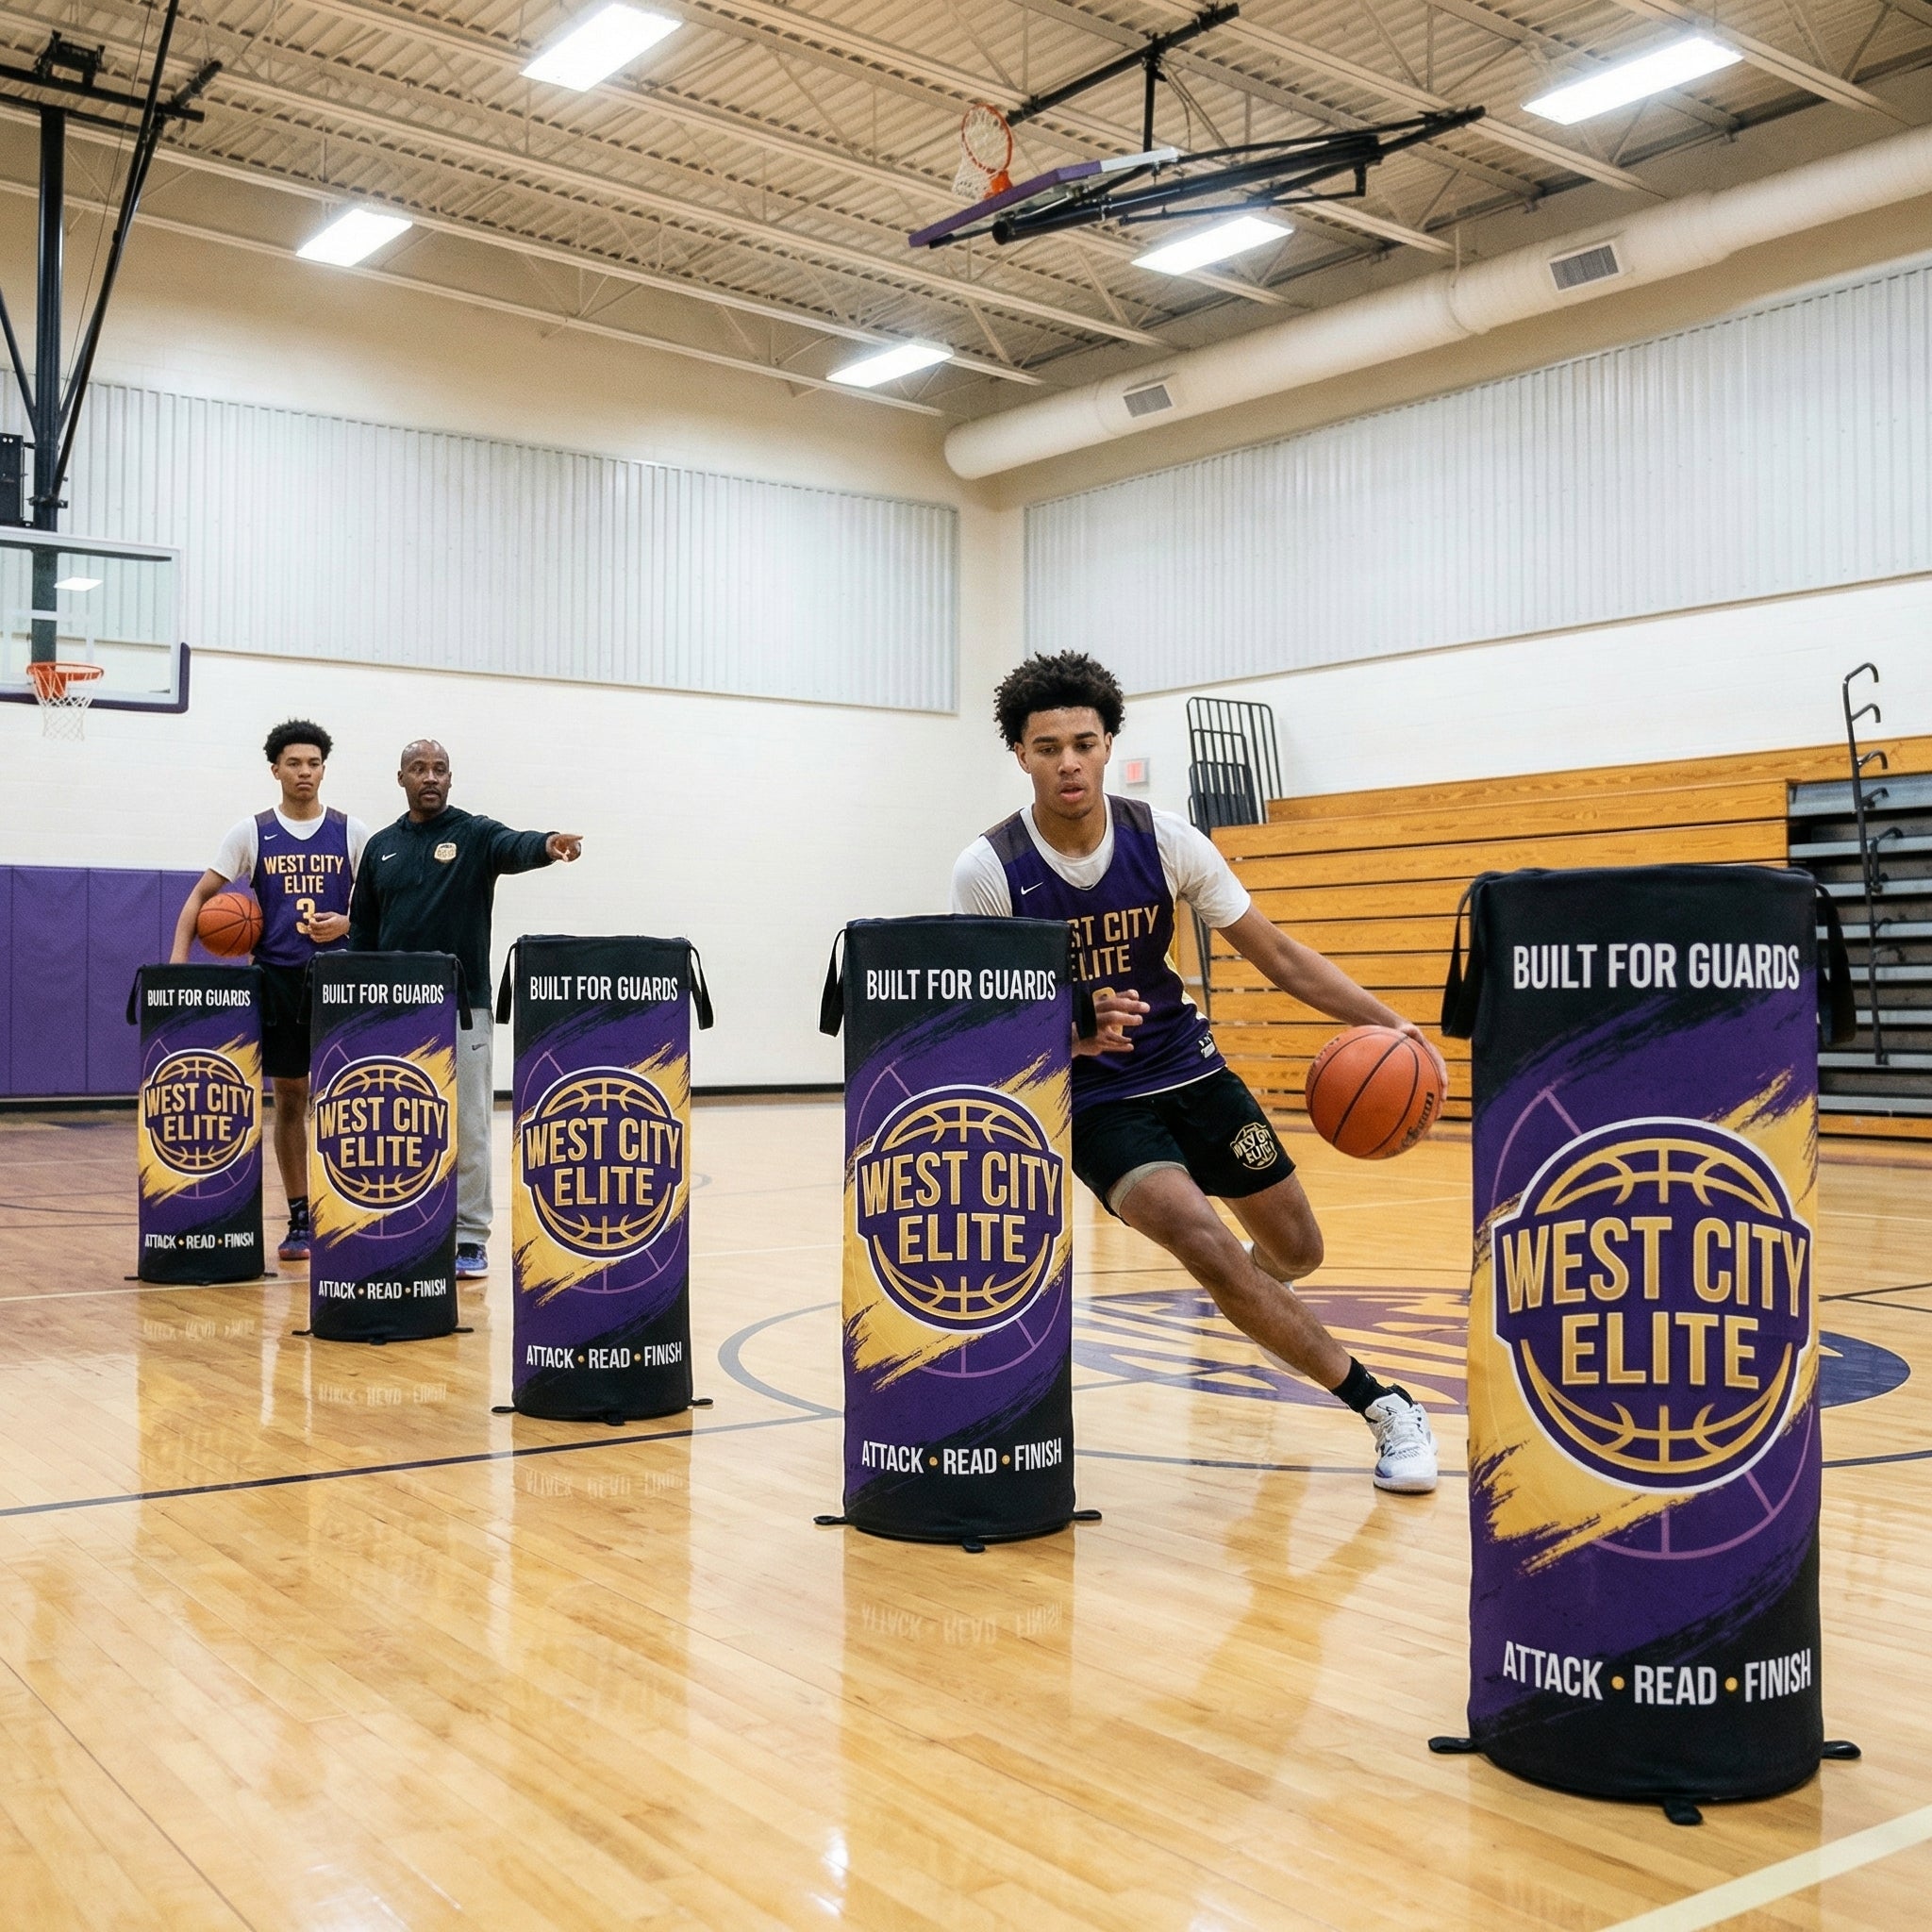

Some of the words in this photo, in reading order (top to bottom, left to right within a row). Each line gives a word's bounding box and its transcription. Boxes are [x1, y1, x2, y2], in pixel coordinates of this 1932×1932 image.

[263, 854, 306, 874] WEST
[309, 854, 344, 874] CITY
[284, 874, 325, 894] ELITE
[295, 897, 316, 934] 3
[1103, 905, 1159, 942] CITY
[1513, 944, 1598, 989] BUILT
[1608, 942, 1677, 988] FOR
[1689, 942, 1800, 990] GUARDS
[147, 990, 175, 1007] BUILT
[177, 989, 202, 1006] FOR
[206, 990, 251, 1007] GUARDS
[322, 984, 356, 1004] BUILT
[359, 984, 389, 1004] FOR
[392, 984, 444, 1004] GUARDS
[530, 975, 572, 1001] BUILT
[576, 975, 612, 1000] FOR
[617, 975, 678, 1002] GUARDS
[866, 969, 921, 1001] BUILT
[927, 969, 973, 1000] FOR
[979, 969, 1056, 1001] GUARDS
[146, 1082, 200, 1118] WEST
[207, 1083, 252, 1117] CITY
[319, 1096, 385, 1140] WEST
[393, 1096, 446, 1140] CITY
[163, 1114, 233, 1142] ELITE
[525, 1117, 608, 1170] WEST
[619, 1117, 679, 1169] CITY
[340, 1136, 423, 1169] ELITE
[554, 1166, 654, 1207] ELITE
[861, 1151, 969, 1218] WEST
[982, 1151, 1059, 1216] CITY
[144, 1233, 177, 1249] ATTACK
[186, 1234, 216, 1250] READ
[225, 1231, 254, 1248] FINISH
[898, 1212, 1026, 1264] ELITE
[1502, 1216, 1673, 1314] WEST
[1692, 1217, 1807, 1318] CITY
[318, 1280, 356, 1299] ATTACK
[367, 1282, 402, 1300] READ
[413, 1278, 446, 1298] FINISH
[526, 1344, 575, 1369] ATTACK
[588, 1348, 631, 1369] READ
[643, 1341, 682, 1367] FINISH
[1562, 1311, 1759, 1391] ELITE
[861, 1441, 924, 1474] ATTACK
[943, 1448, 997, 1474] READ
[1014, 1437, 1062, 1472] FINISH
[1503, 1640, 1603, 1701] ATTACK
[1634, 1664, 1717, 1706] READ
[1745, 1648, 1811, 1703] FINISH
